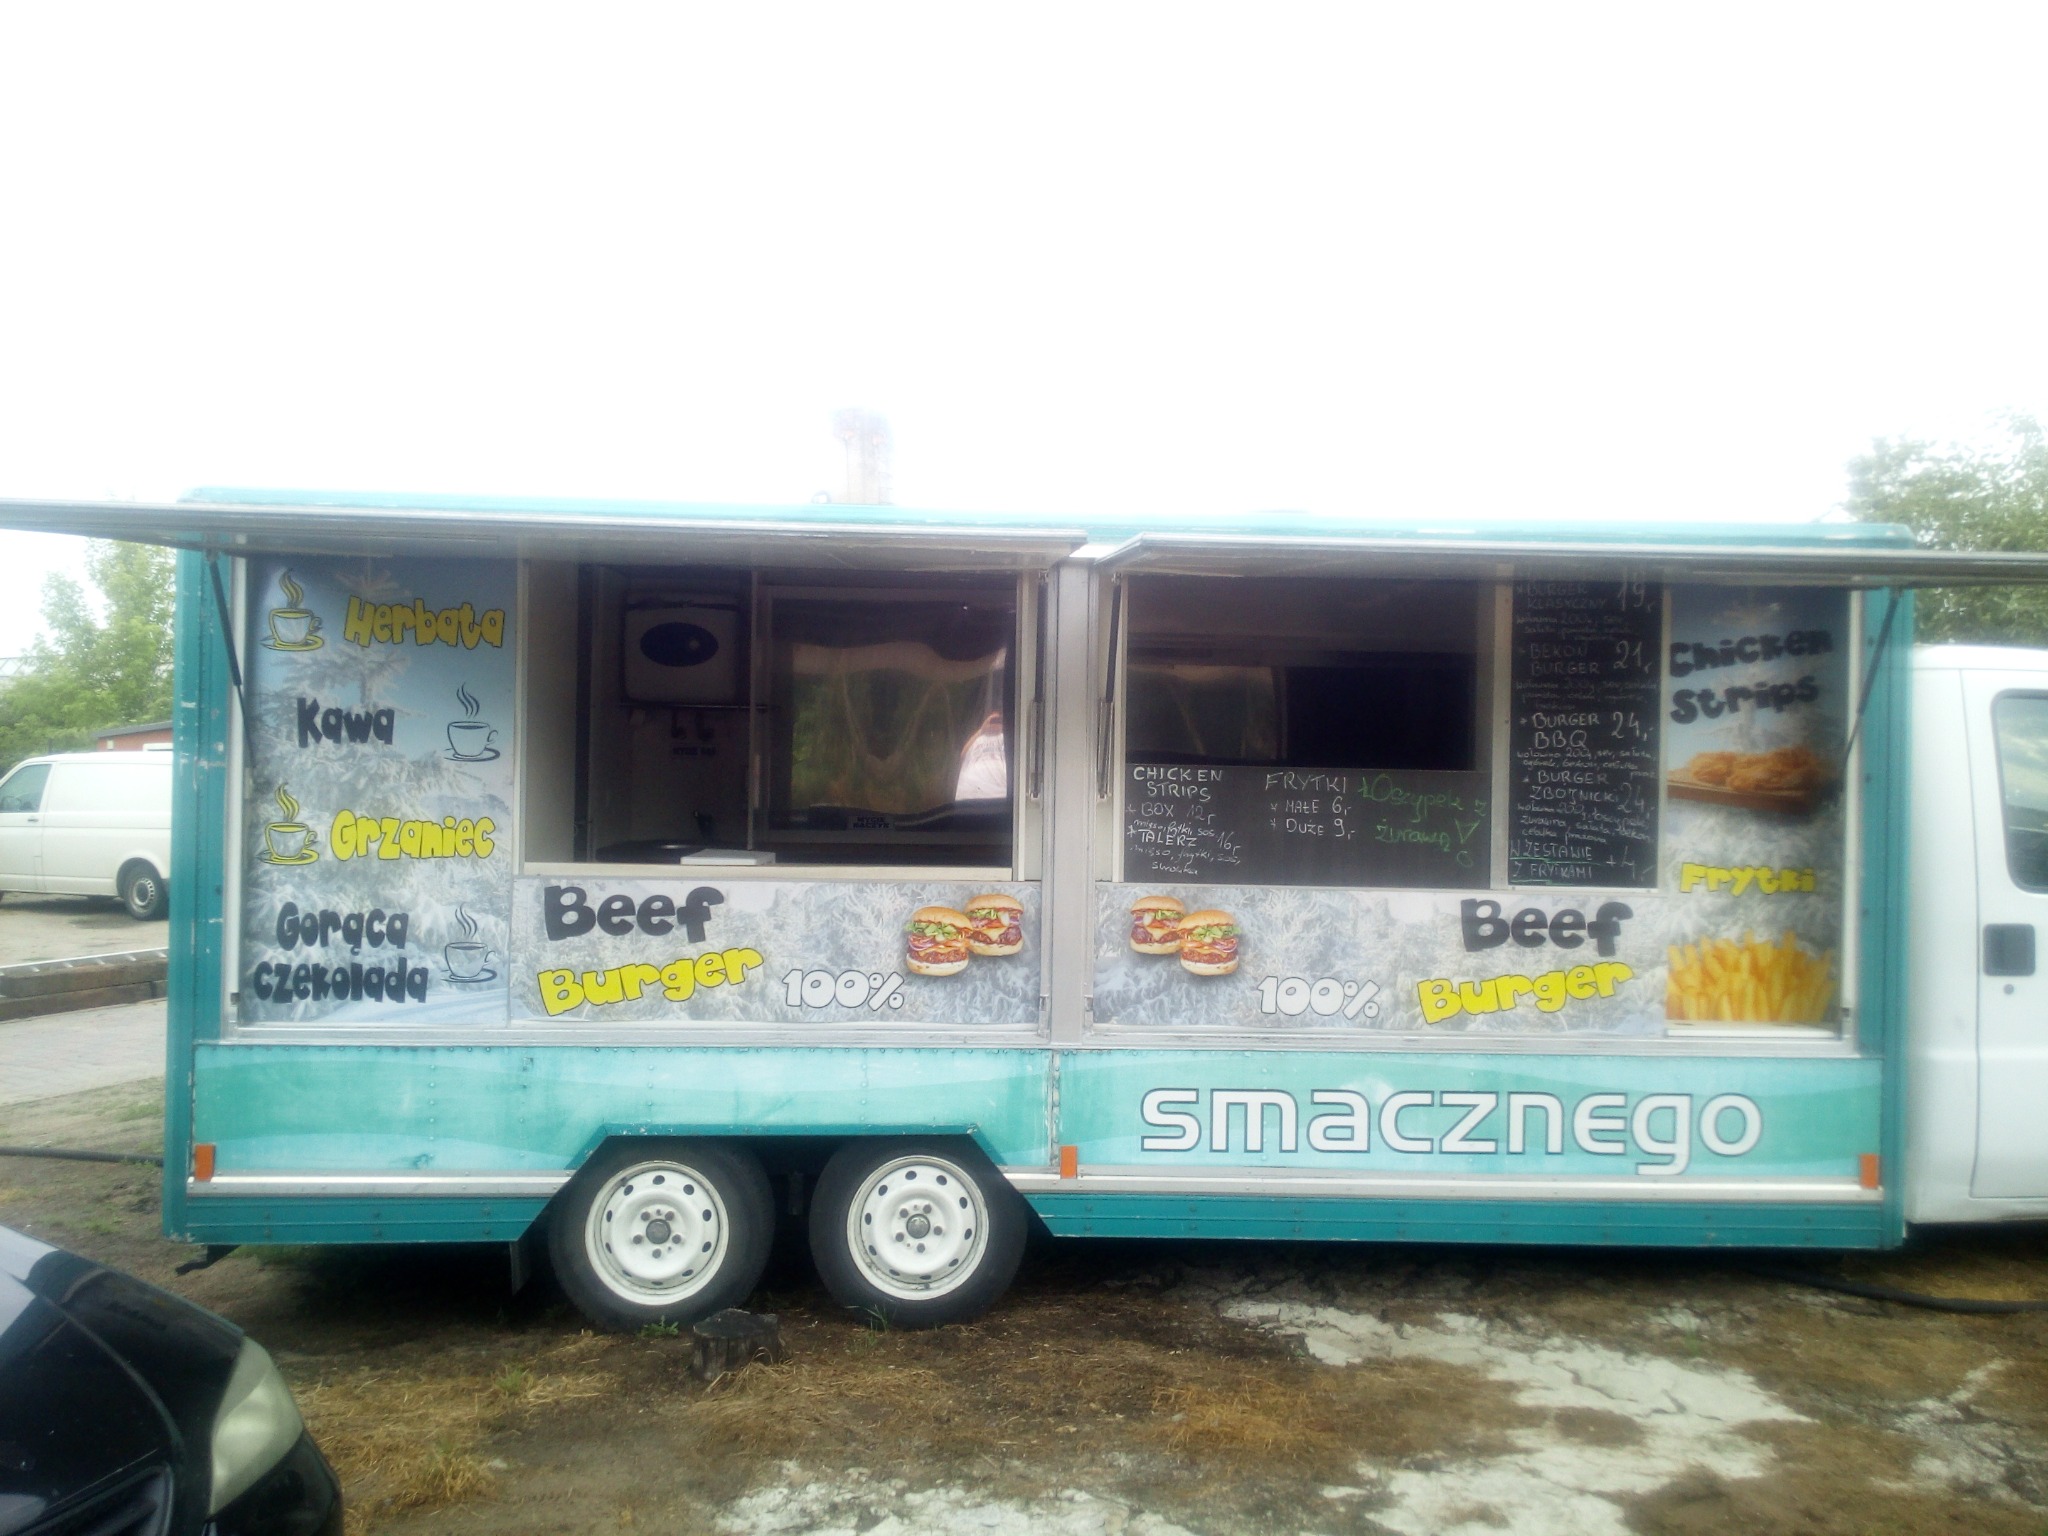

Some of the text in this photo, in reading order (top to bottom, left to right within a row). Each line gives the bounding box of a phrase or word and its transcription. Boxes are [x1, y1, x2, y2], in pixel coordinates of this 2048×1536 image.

[343, 596, 505, 650] Herbata
[1531, 660, 1600, 676] BURGER
[1669, 629, 1833, 678] Chicken
[1670, 675, 1820, 725] Strips
[296, 697, 395, 750] Kawa
[1532, 711, 1600, 729] BURGER
[1534, 729, 1589, 750] BBQ
[1133, 766, 1223, 782] CHICKEN
[1147, 781, 1212, 802] STRIPS
[1265, 771, 1346, 794] FRYTKI
[1538, 770, 1610, 785] BURGER
[1141, 802, 1174, 818] BOX
[1286, 799, 1320, 814] MAŁE
[330, 809, 496, 862] Grzaniec
[1138, 829, 1198, 847] TALERZ
[1286, 818, 1324, 836] DUŻE
[1523, 839, 1593, 860] ZESTAWIE
[1530, 863, 1592, 879] FRYTKAMI
[1679, 862, 1816, 897] Frytki
[276, 900, 409, 956] Gorąca
[543, 885, 725, 944] Beef
[1460, 897, 1635, 958] Beef
[253, 958, 428, 1004] czekolada
[537, 947, 764, 1017] Burger
[782, 968, 905, 1012] 100%
[1256, 975, 1381, 1020] 100%
[1416, 961, 1634, 1025] Burger
[1140, 1086, 1763, 1176] smacznego
